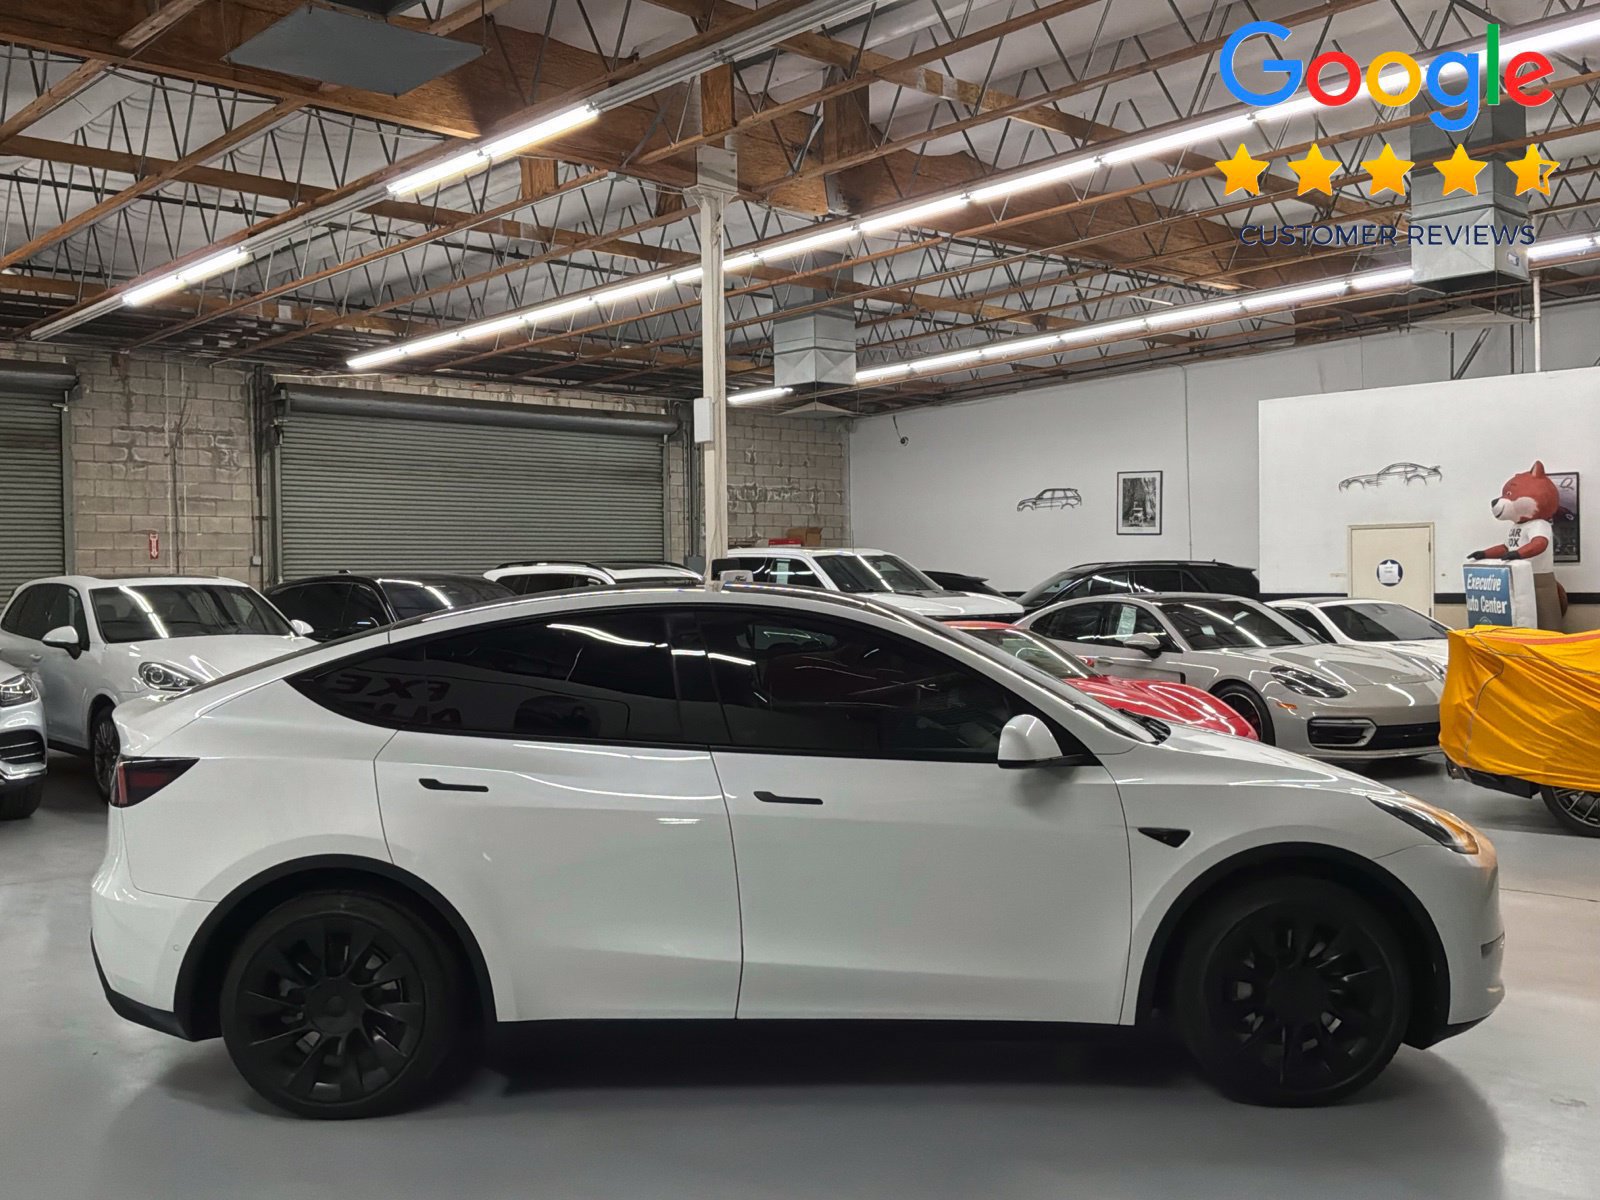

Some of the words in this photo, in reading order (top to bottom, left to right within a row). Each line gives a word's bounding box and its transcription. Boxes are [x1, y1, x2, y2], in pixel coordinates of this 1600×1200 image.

[1467, 573, 1502, 592] Executive
[1467, 595, 1479, 612] uto
[1480, 595, 1508, 614] Center
